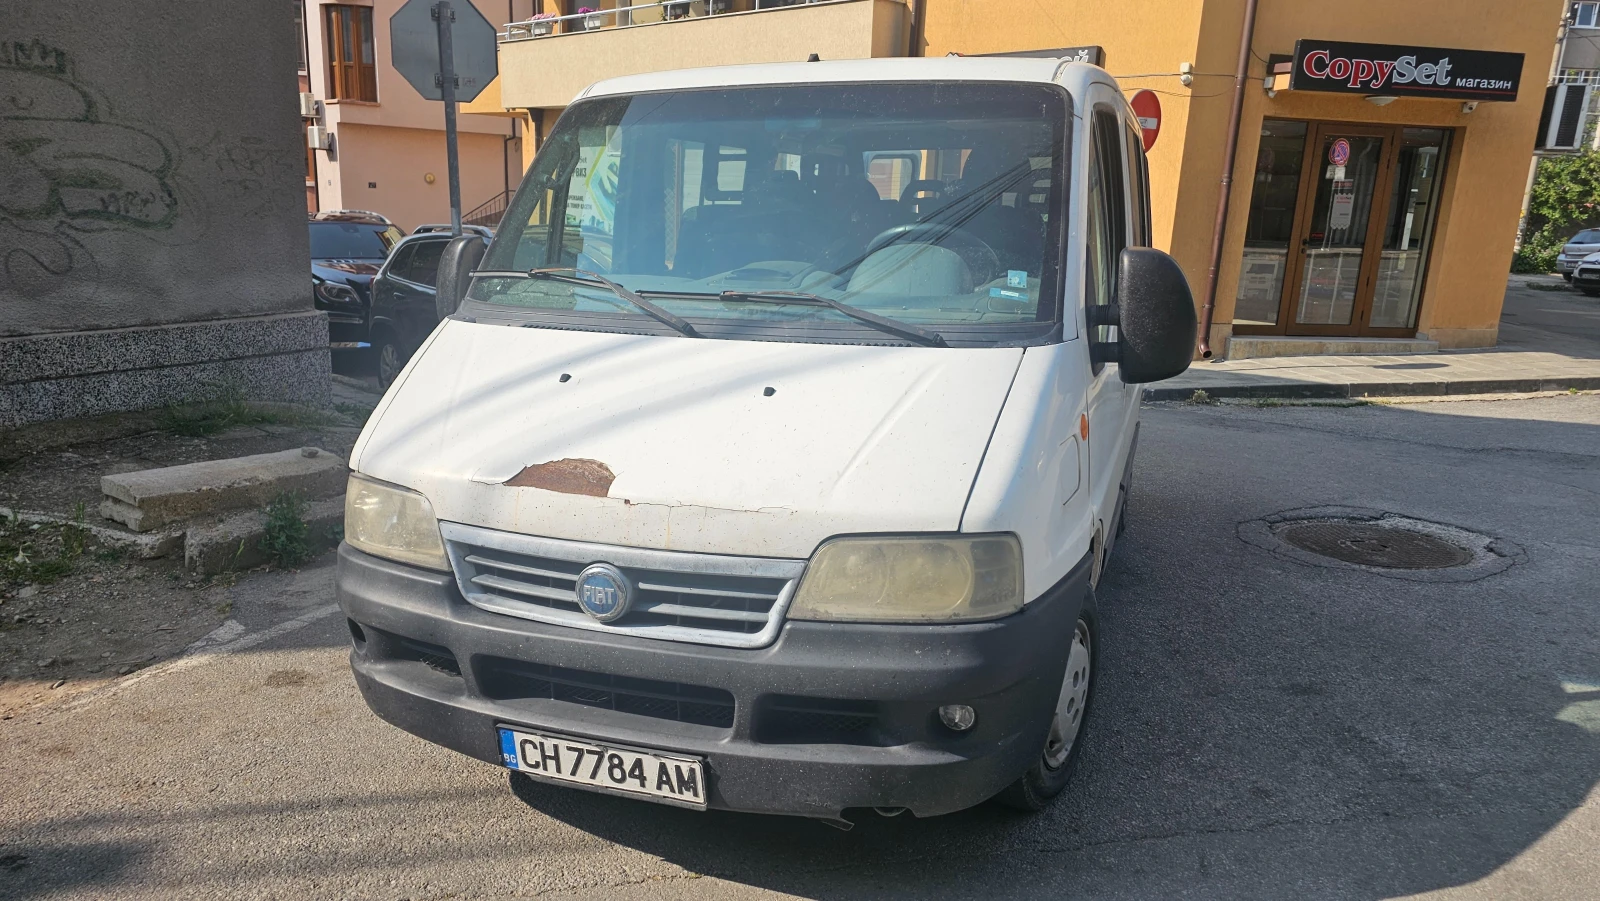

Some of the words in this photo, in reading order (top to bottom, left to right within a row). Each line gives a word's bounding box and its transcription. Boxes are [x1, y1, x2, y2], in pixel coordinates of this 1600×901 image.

[1303, 50, 1452, 88] CopySet
[1455, 77, 1512, 90] магазин
[583, 584, 615, 605] FIAT
[503, 753, 517, 763] BG
[655, 761, 700, 798] AM
